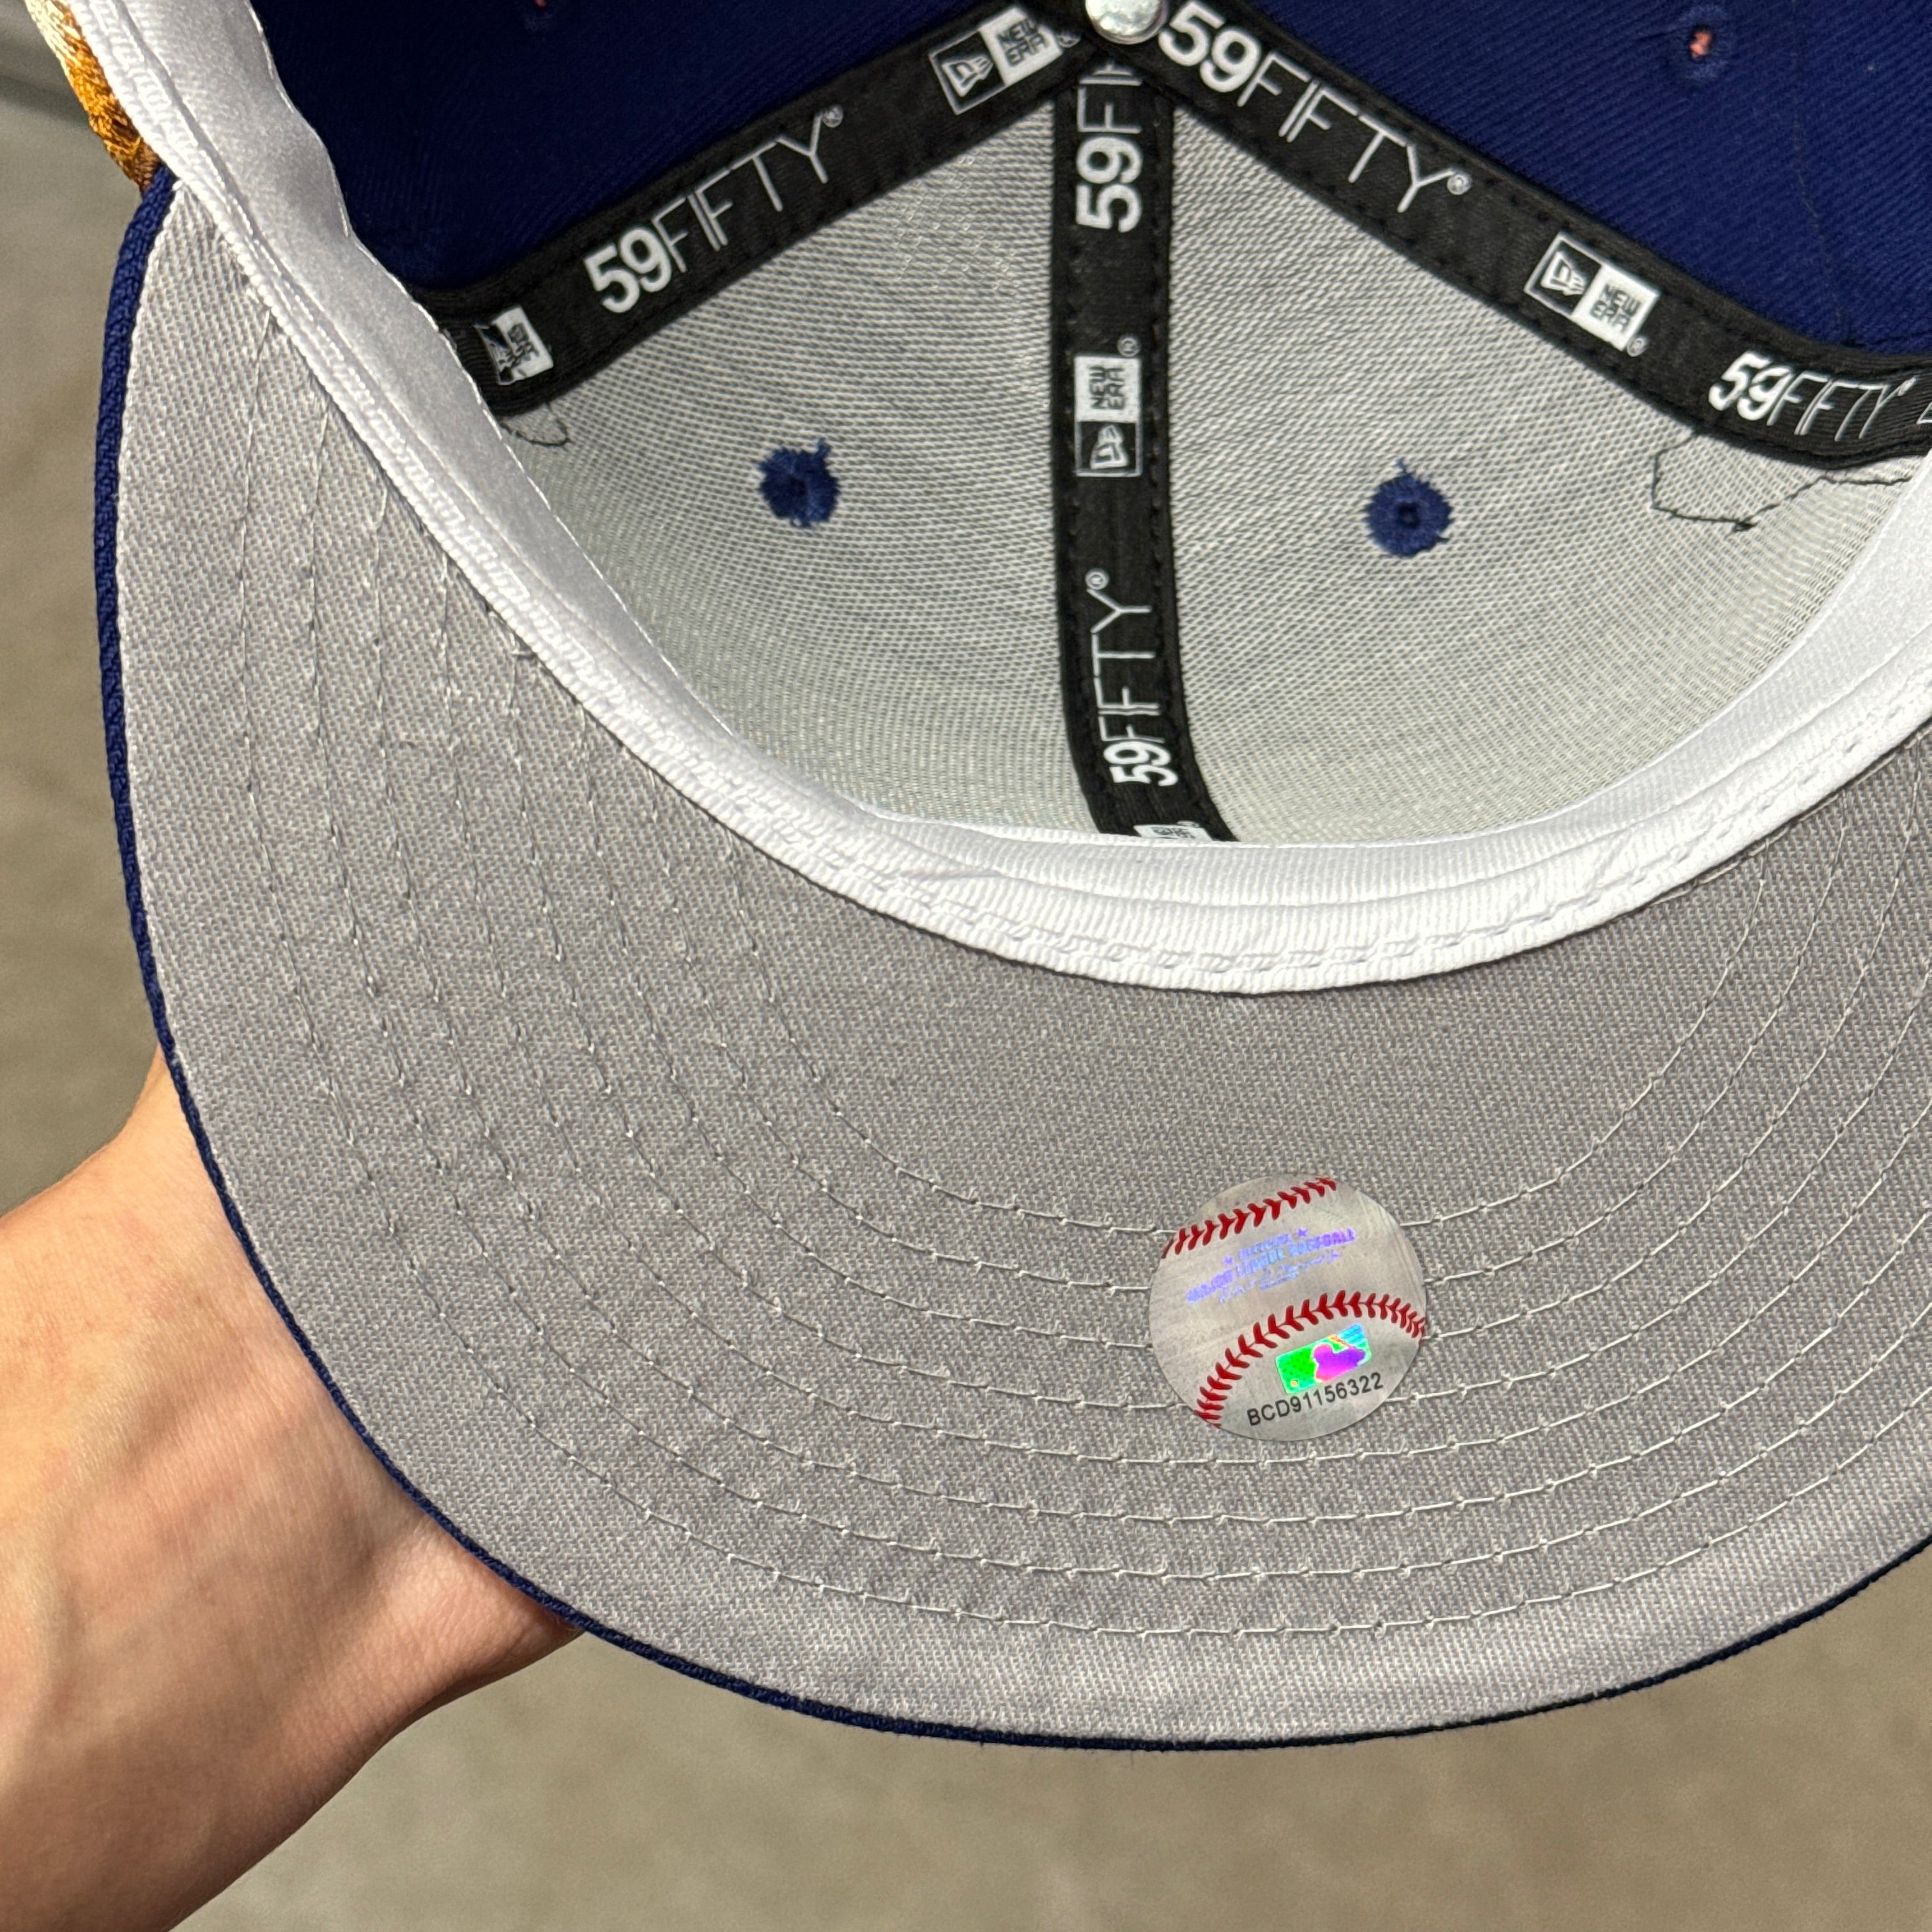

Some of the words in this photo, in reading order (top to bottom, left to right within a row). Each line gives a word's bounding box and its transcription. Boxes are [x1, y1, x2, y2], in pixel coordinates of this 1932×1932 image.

[1589, 299, 1630, 334] ERA
[1602, 284, 1642, 317] NEW
[1088, 365, 1107, 410] NEW
[1106, 366, 1125, 410] ERA
[1246, 1372, 1384, 1427] BCD91156322
